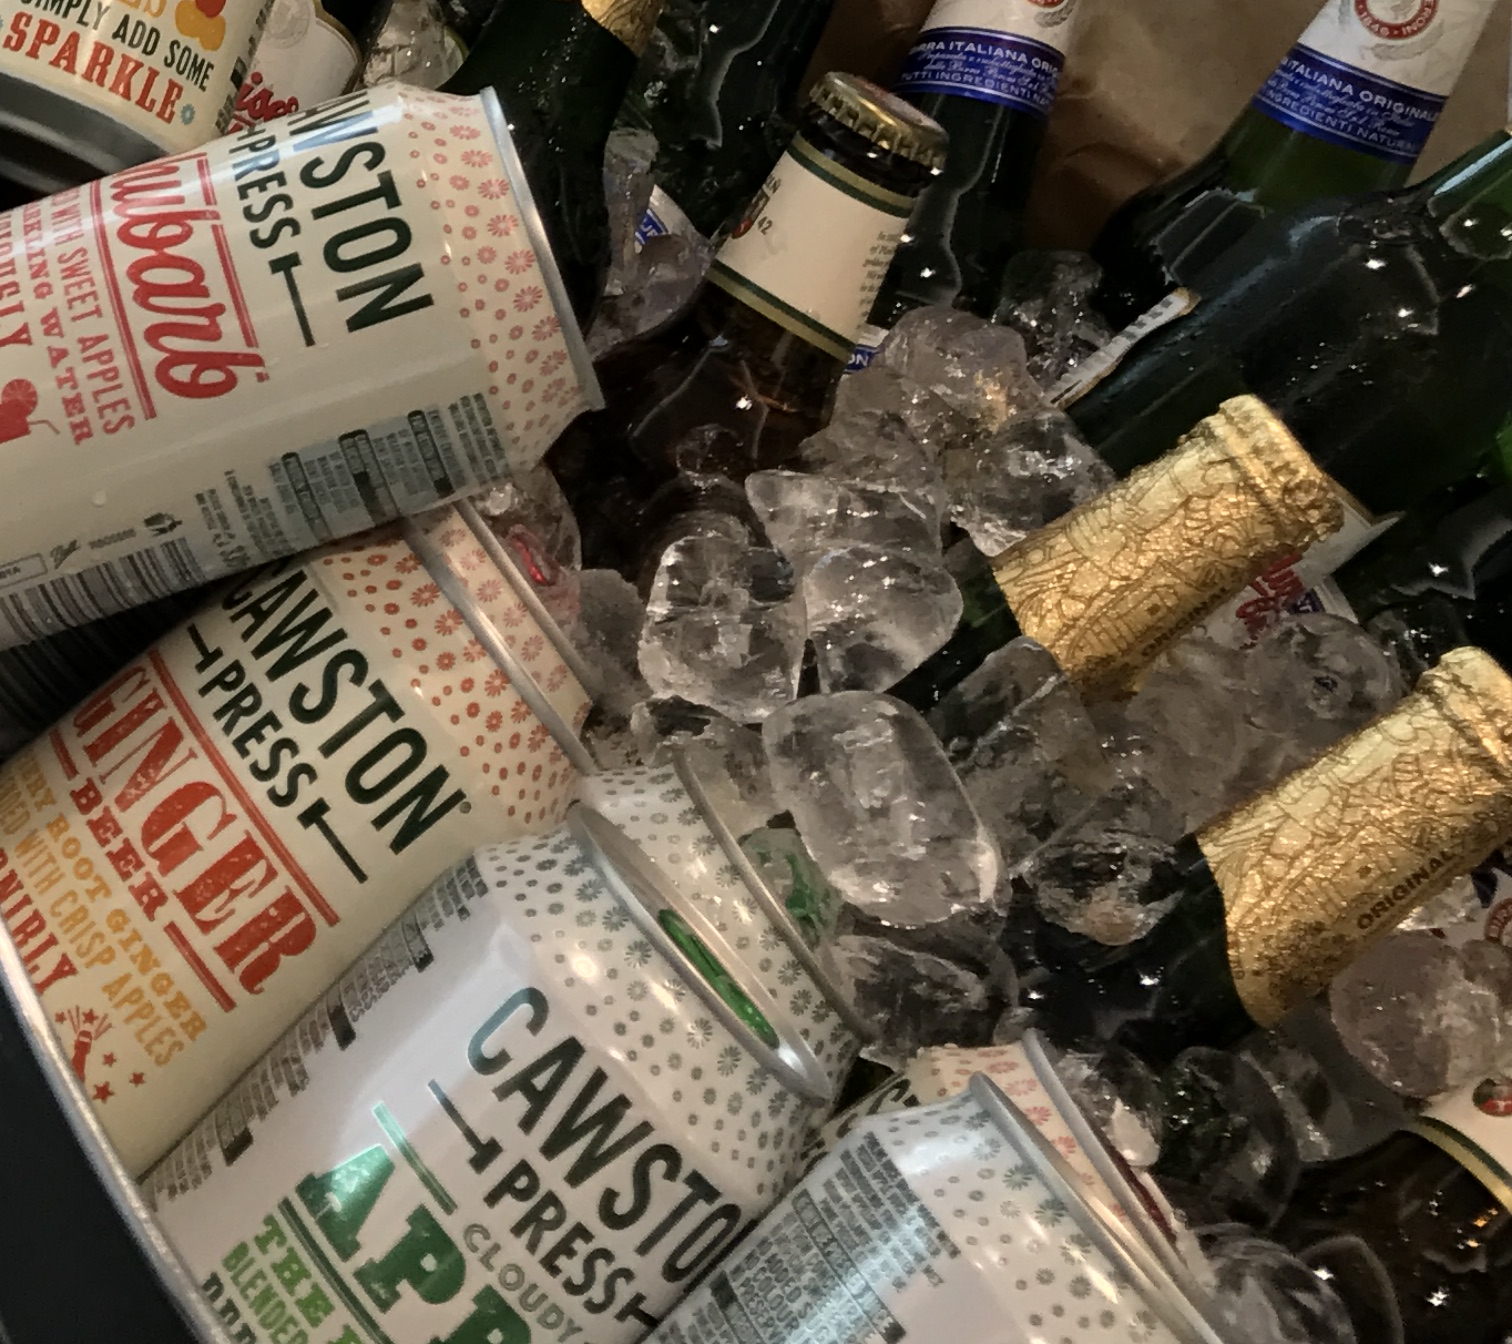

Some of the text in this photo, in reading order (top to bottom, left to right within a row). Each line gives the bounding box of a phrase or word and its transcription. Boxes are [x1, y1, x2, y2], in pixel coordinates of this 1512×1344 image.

[2, 10, 185, 125] SPARKLE
[111, 13, 161, 56] ADD
[163, 39, 215, 93] SOME
[934, 70, 1031, 98] INGREDIENTI
[948, 40, 1028, 64] ITALIANA
[1286, 60, 1438, 122] ITALIANA ORIGINAL
[51, 202, 85, 247] WITH
[229, 132, 302, 250] PRESS
[287, 88, 435, 334] AWSTON
[757, 215, 774, 236] 42
[22, 201, 94, 446] ARKLING WATER
[56, 246, 104, 323] SWEET
[108, 154, 271, 400] hubarb
[76, 333, 136, 435] APPLES
[198, 658, 319, 809] PRESS
[69, 776, 170, 922] BEER
[72, 664, 318, 997] GINGER
[14, 827, 66, 897] WITH
[49, 888, 117, 970] CRISP
[101, 972, 186, 1068] APPLES
[46, 813, 113, 900] ROOT
[105, 907, 207, 1042] GINGER
[1356, 849, 1458, 931] ORIGINAL
[466, 985, 743, 1284] CAWSTO
[253, 1213, 337, 1329] THE
[295, 1141, 534, 1344] APP
[462, 1221, 585, 1344] CLOUDY
[482, 1159, 638, 1317] PRESS
[762, 1251, 803, 1304] ADDED
[736, 1275, 787, 1344] PRESERV
